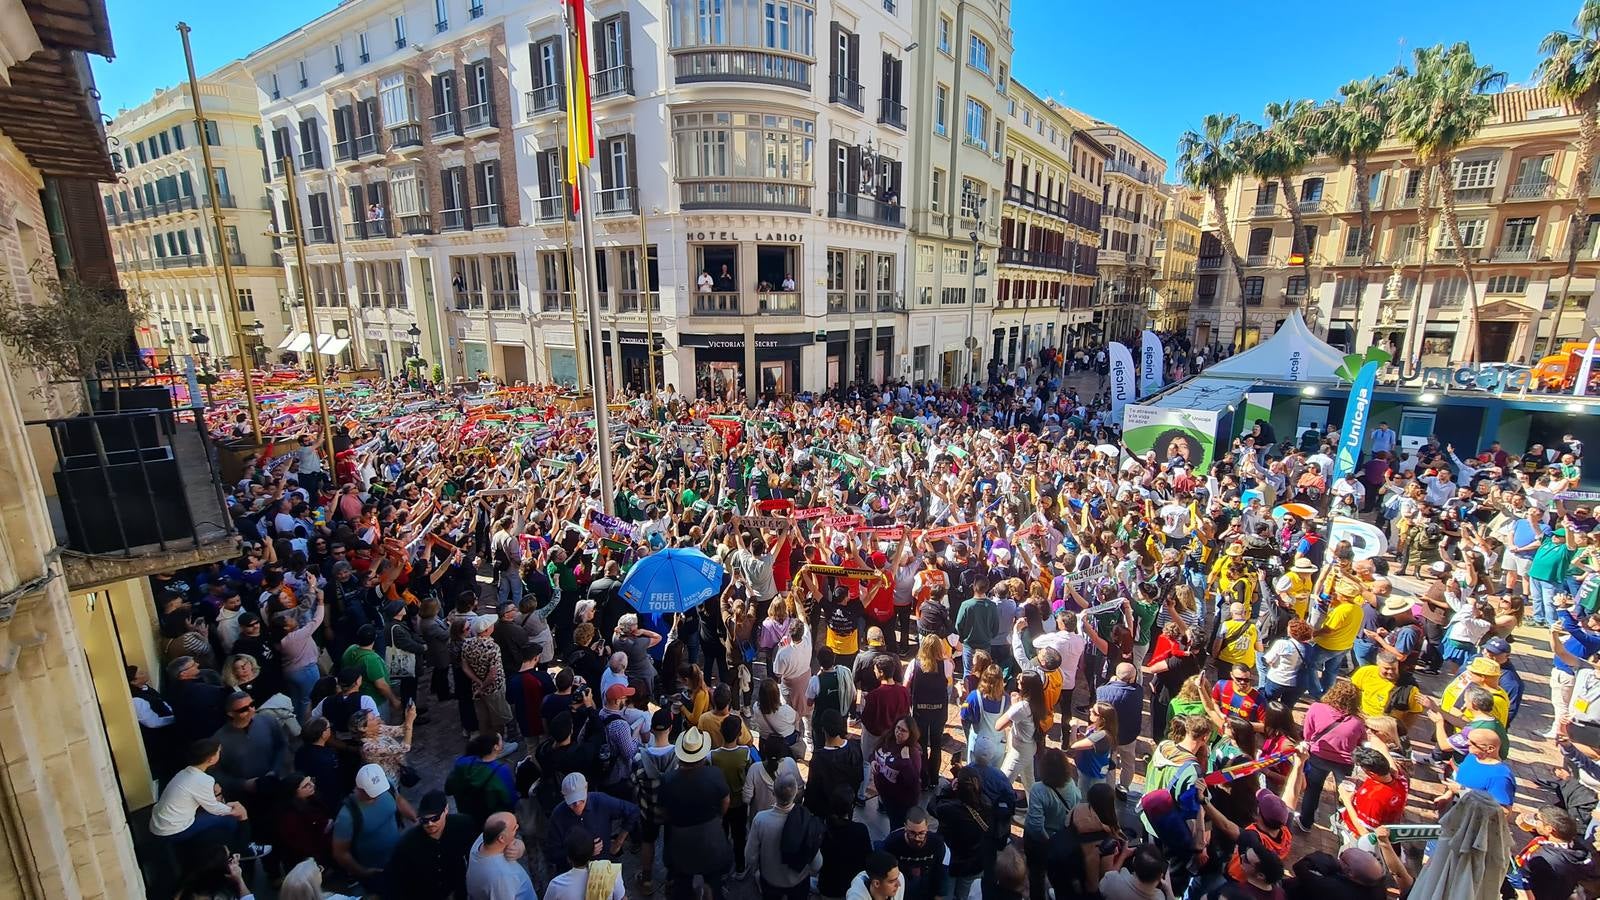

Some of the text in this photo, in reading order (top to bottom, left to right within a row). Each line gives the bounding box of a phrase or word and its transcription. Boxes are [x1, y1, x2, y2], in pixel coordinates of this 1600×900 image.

[687, 232, 803, 242] HOTEL LARIOS
[708, 340, 778, 348] VICTORIA'S SECRET
[1347, 388, 1368, 447] Unicaja
[650, 592, 674, 601] FREE
[648, 601, 676, 610] TOUR
[1397, 827, 1443, 836] Unic
